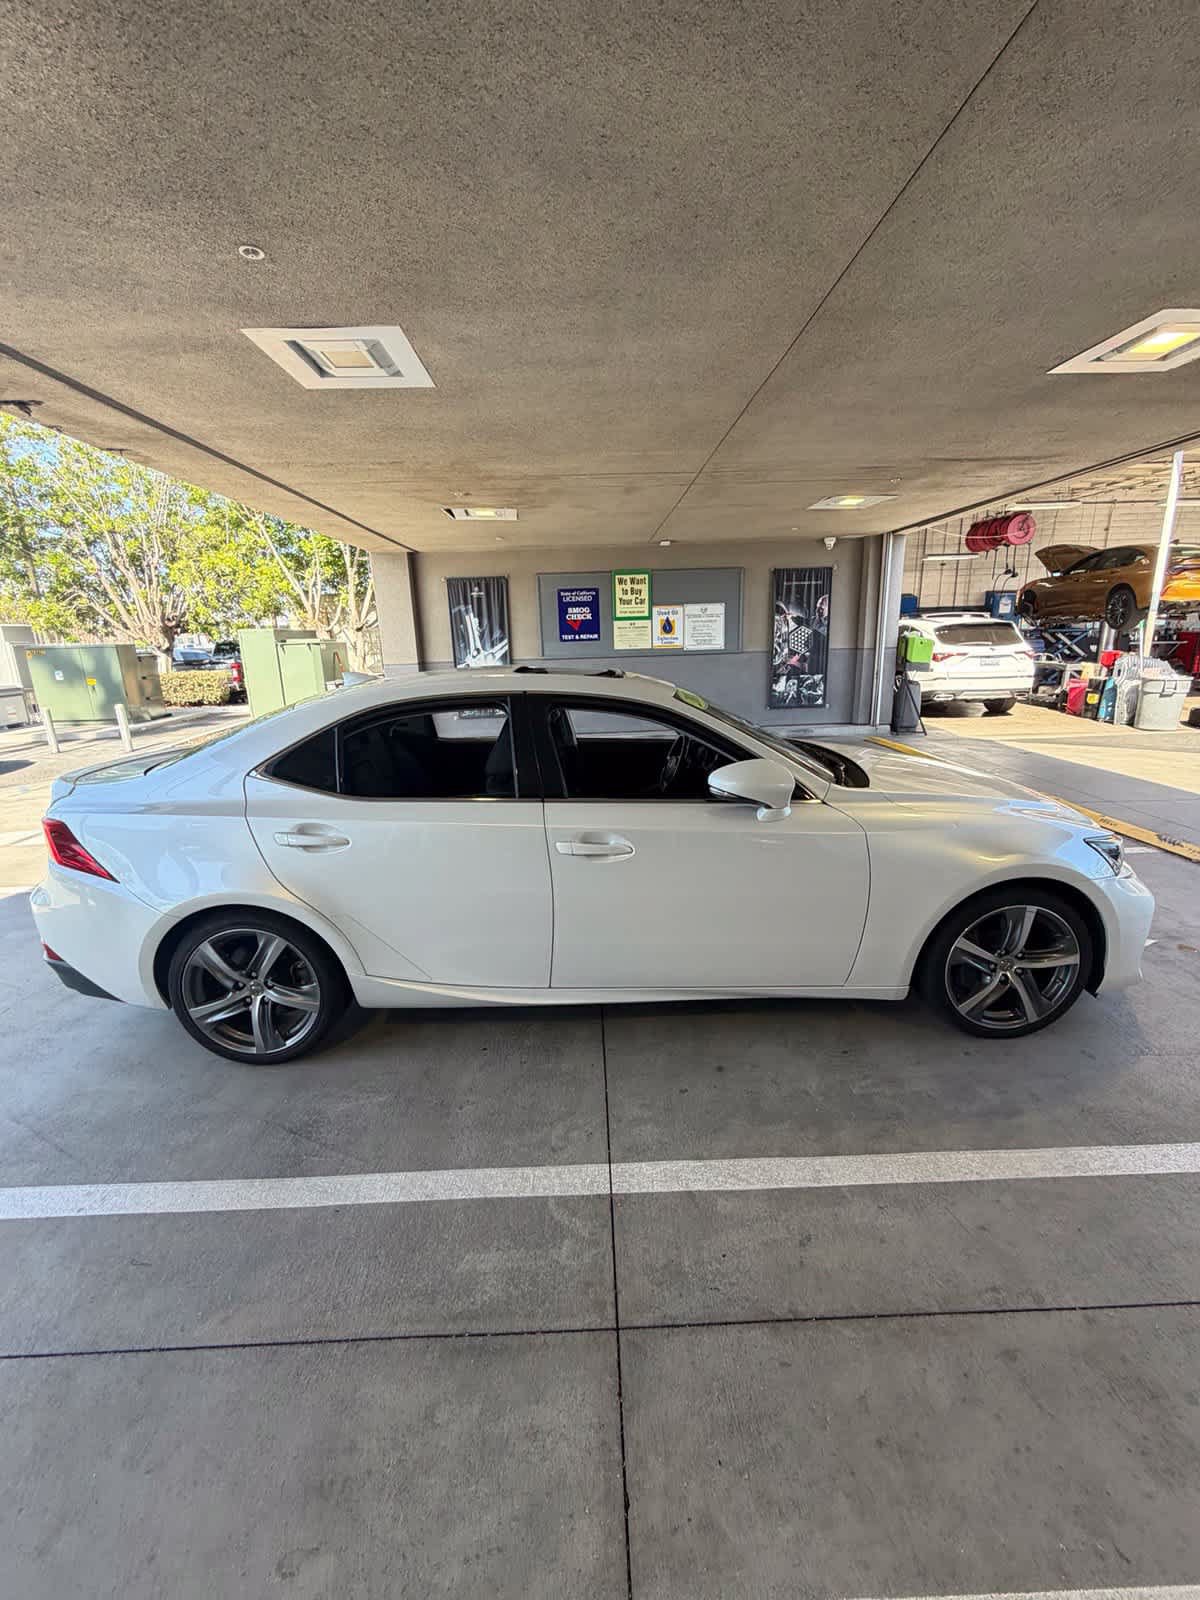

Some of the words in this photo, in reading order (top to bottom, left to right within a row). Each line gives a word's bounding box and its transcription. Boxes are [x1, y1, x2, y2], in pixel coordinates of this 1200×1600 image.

[617, 577, 628, 585] We
[629, 576, 647, 585] Want
[630, 586, 642, 596] Buy
[618, 597, 633, 606] Your
[634, 596, 646, 605] Car
